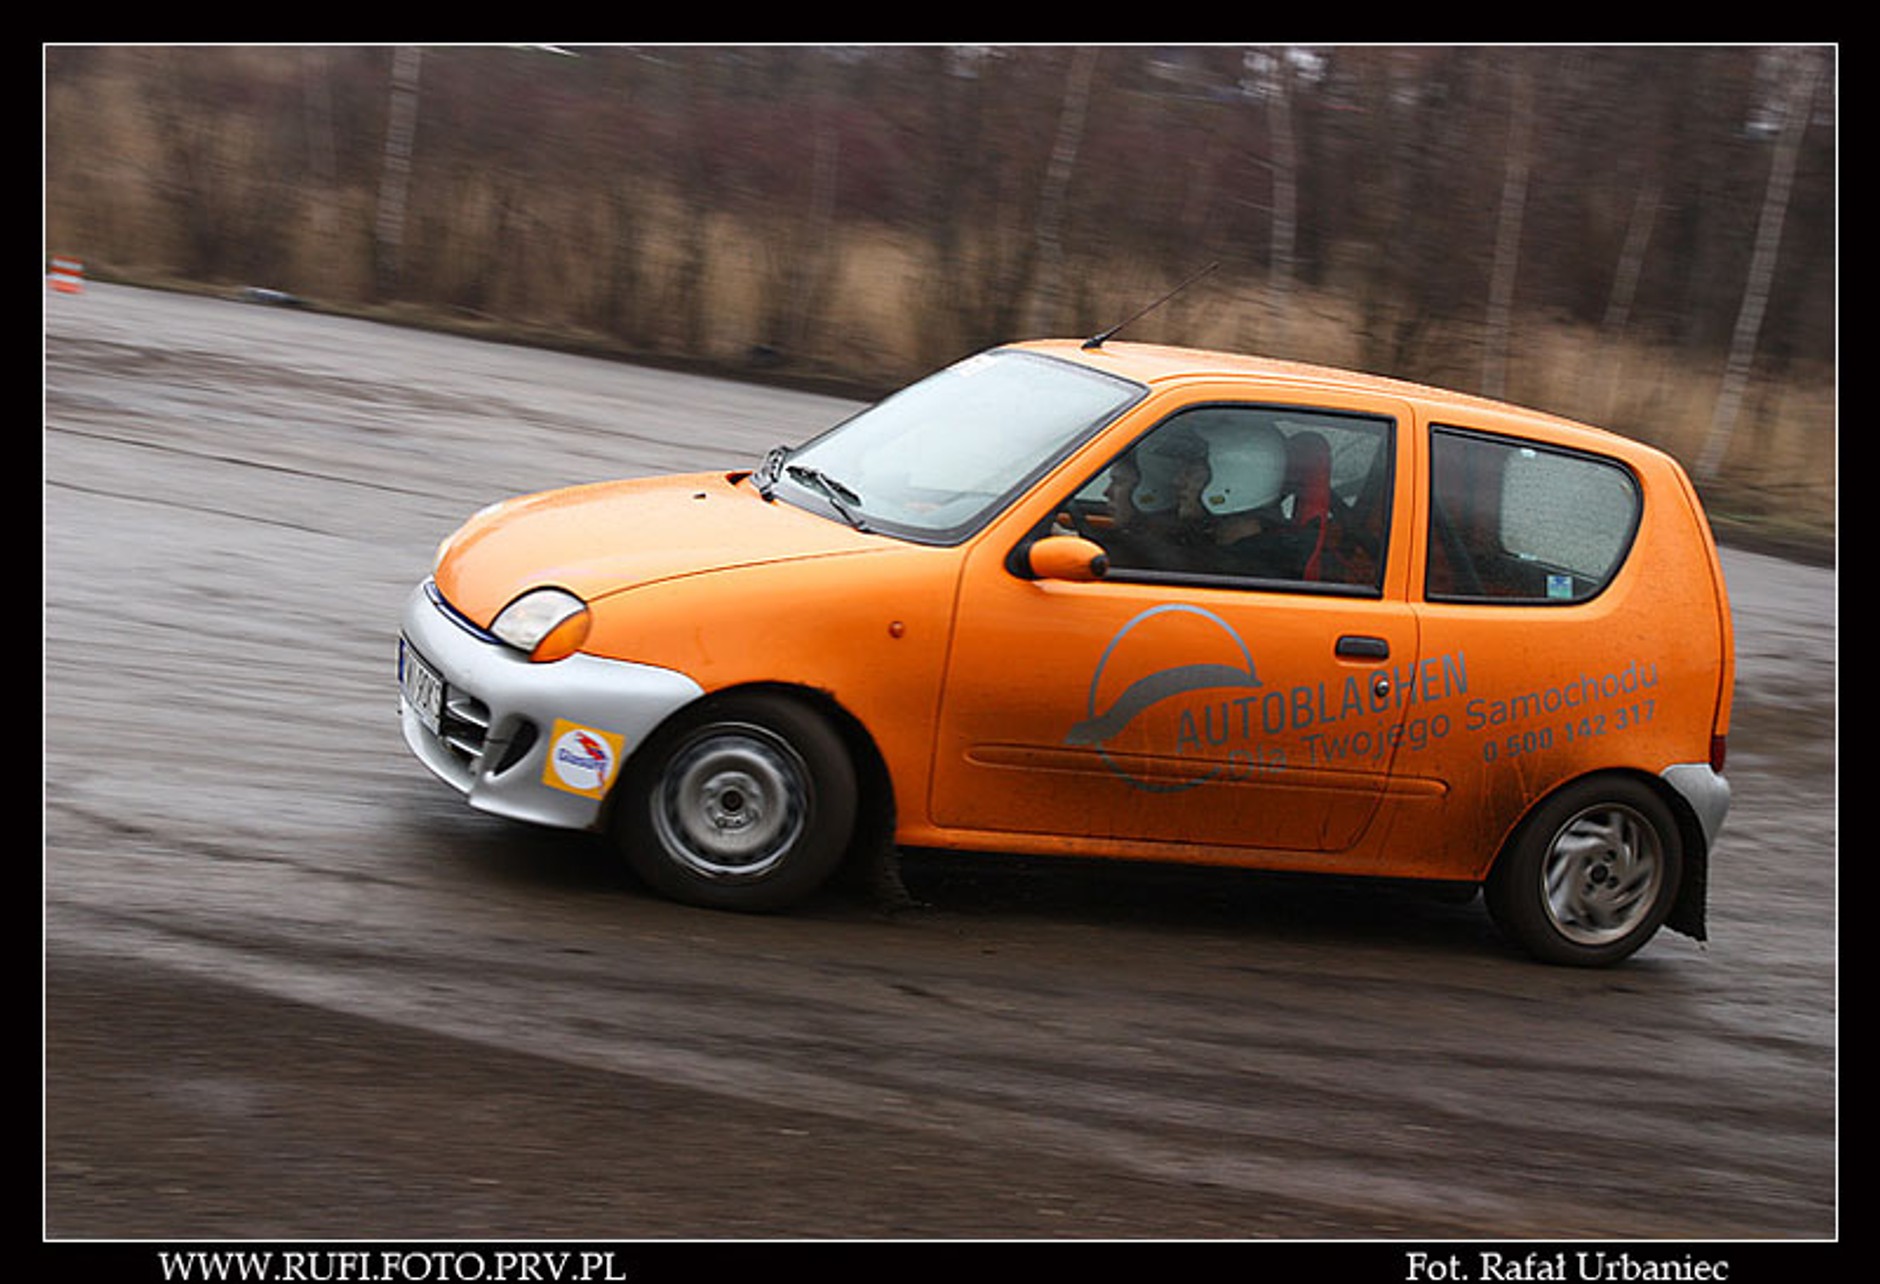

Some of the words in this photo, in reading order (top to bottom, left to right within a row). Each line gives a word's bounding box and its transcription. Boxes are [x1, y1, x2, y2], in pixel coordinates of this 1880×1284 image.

[1176, 651, 1468, 754] AUTOBLACHEN
[1228, 742, 1287, 783] Dla
[1300, 713, 1451, 766] Twojego
[1465, 659, 1659, 731] Samochodu
[1482, 740, 1499, 763] 0
[1564, 714, 1608, 744] 142
[1613, 698, 1656, 731] 317
